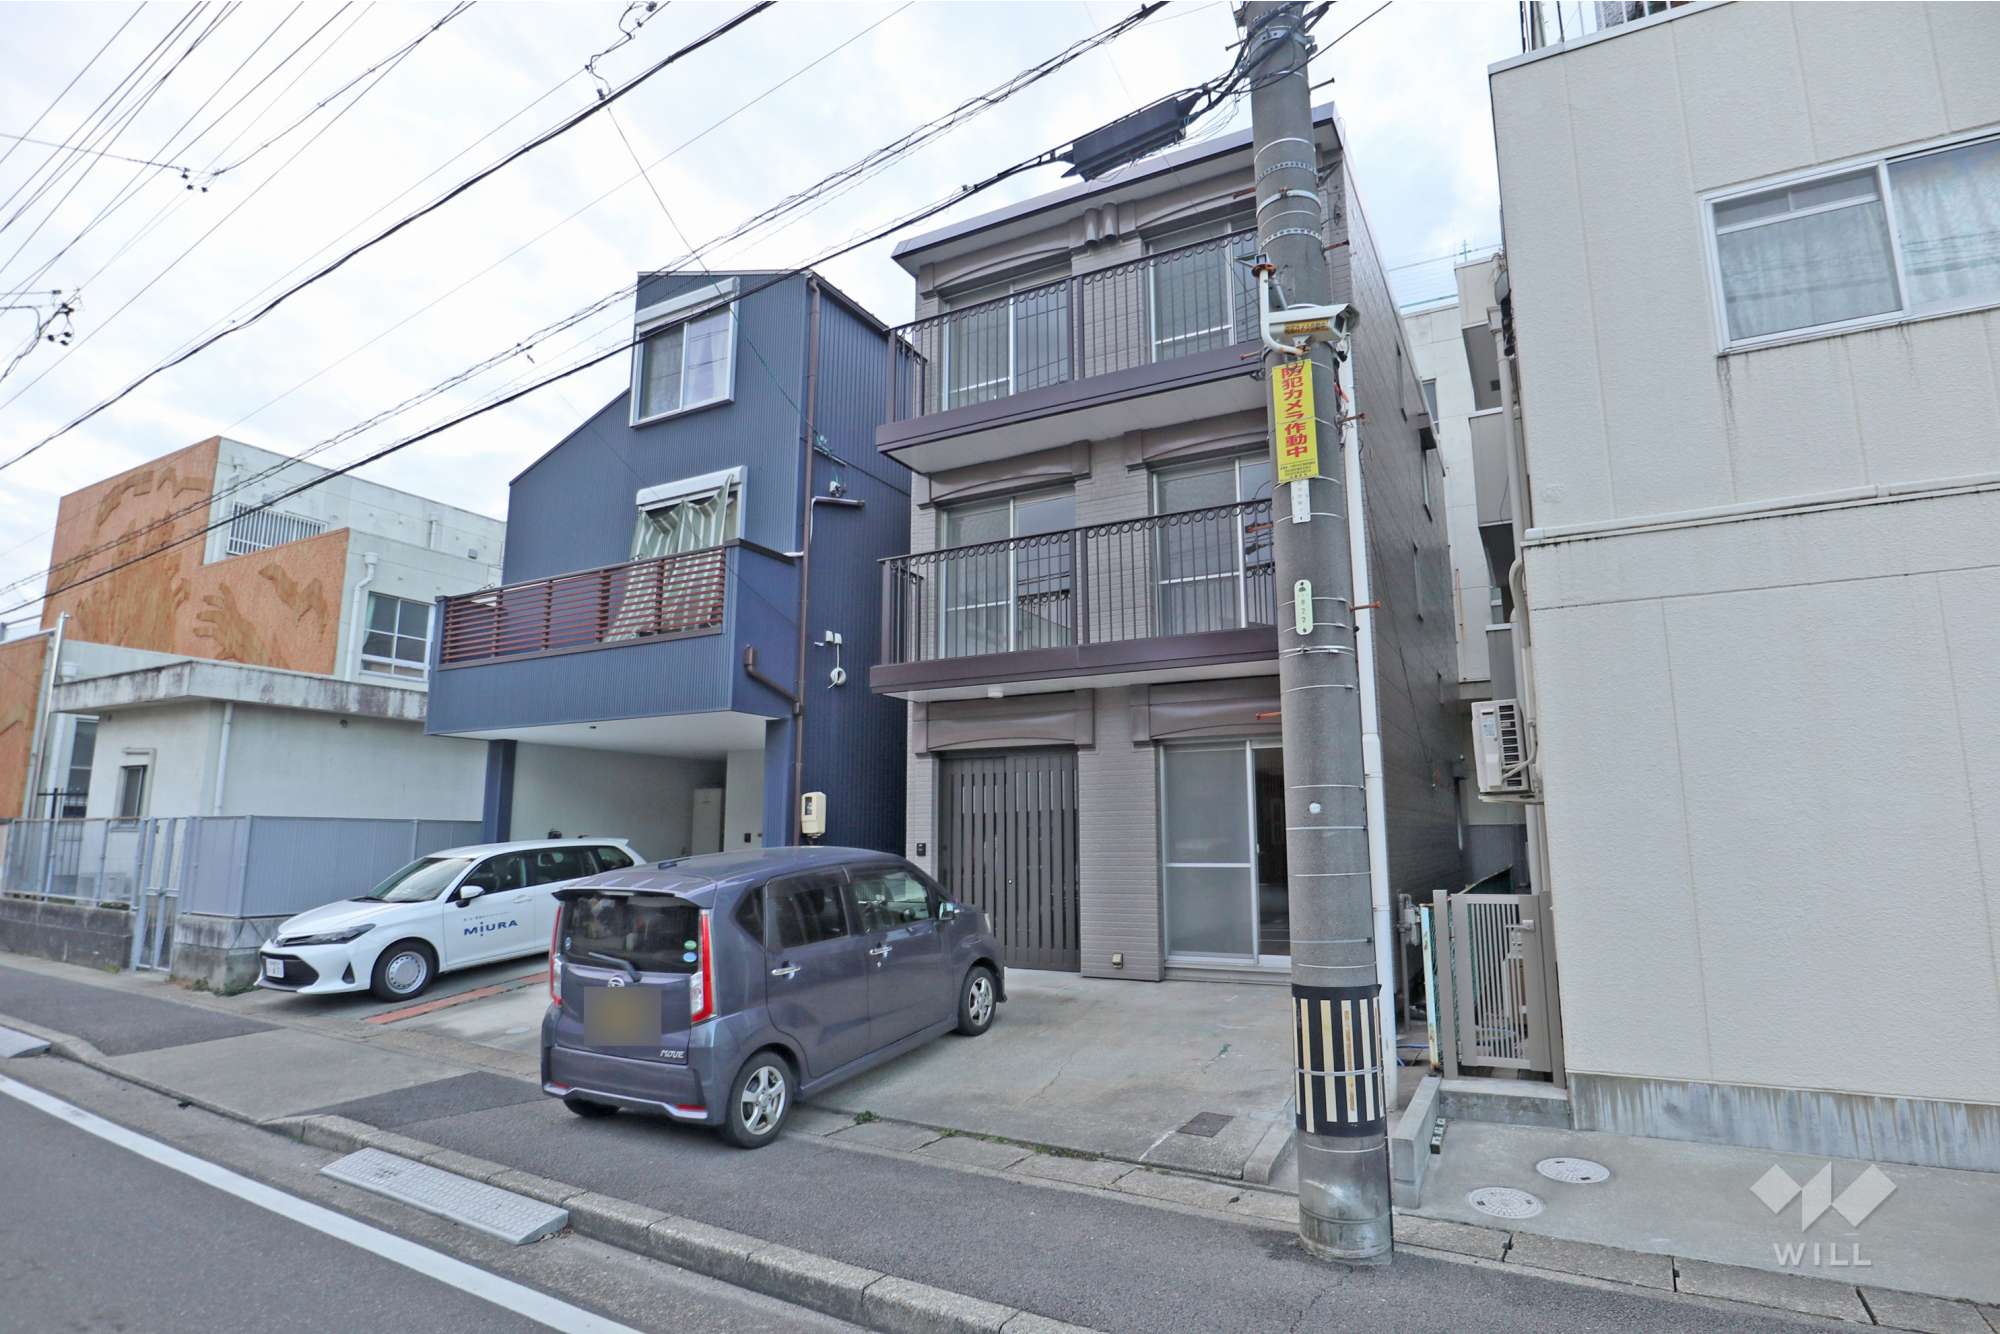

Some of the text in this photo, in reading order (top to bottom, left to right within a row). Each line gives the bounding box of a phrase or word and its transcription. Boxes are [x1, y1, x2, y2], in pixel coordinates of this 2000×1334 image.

[1281, 363, 1308, 457] 防犯カメラ作動中
[660, 1049, 685, 1058] MOVE
